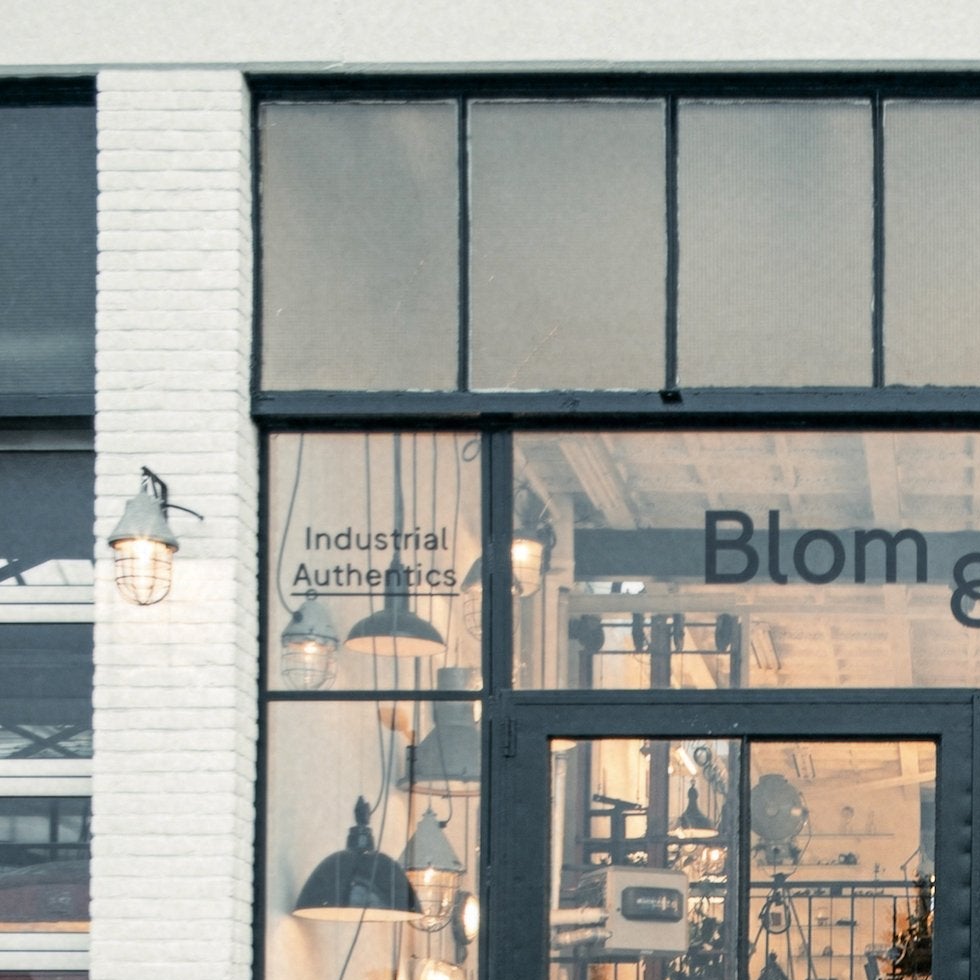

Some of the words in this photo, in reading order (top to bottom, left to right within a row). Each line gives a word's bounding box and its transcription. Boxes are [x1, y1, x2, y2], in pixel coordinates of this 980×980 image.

[305, 526, 449, 550] Industrial
[704, 509, 928, 585] Blom
[292, 563, 457, 587] Authentics
